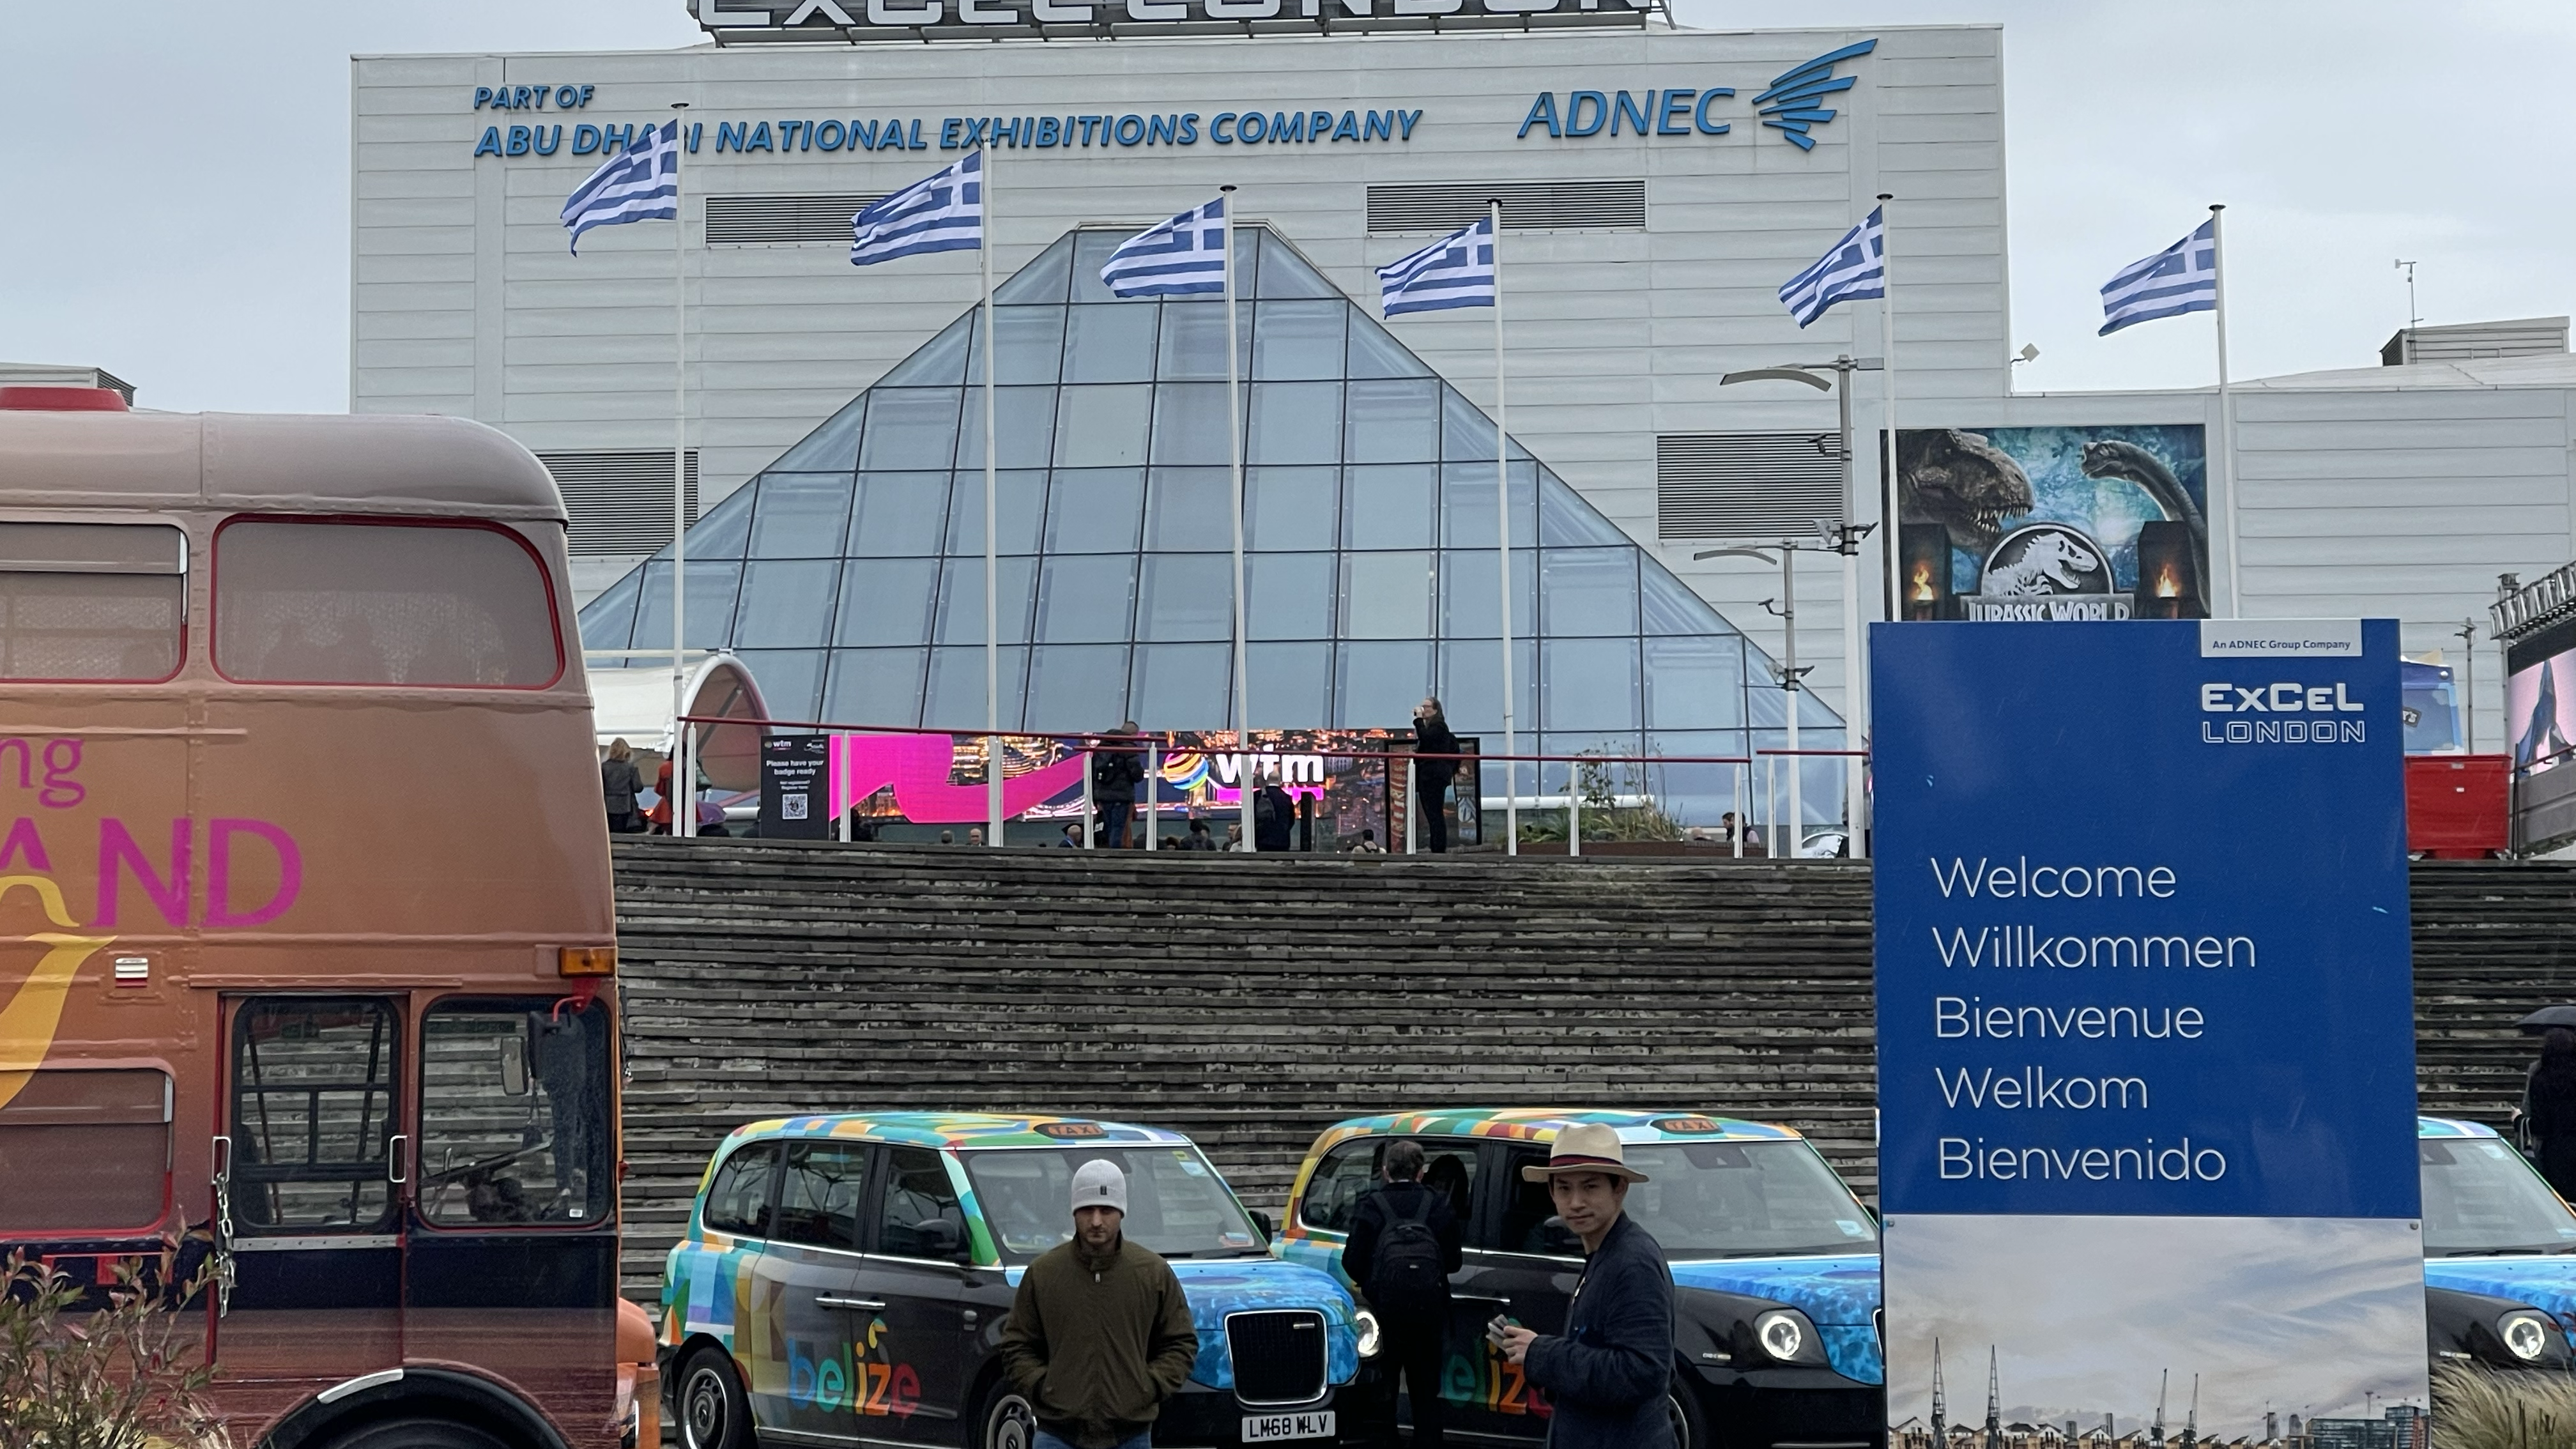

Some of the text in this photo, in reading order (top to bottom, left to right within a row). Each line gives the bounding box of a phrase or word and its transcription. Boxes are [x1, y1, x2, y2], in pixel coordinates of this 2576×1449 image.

[473, 85, 595, 109] PART OF
[1517, 87, 1736, 137] ADNEC
[474, 125, 562, 157] ABU
[716, 119, 927, 152] NATIONAL
[940, 113, 1199, 148] EXHIBITIONS
[1210, 109, 1423, 144] COMPANY
[2212, 640, 2350, 650] An ADNEC Group Company
[2202, 721, 2365, 743] LONDON
[1931, 856, 2175, 898] Welcome
[1933, 926, 2255, 967] Willkommen
[1936, 997, 2204, 1038] Bienvenue
[1936, 1066, 2147, 1108] Welkom
[1053, 1125, 1101, 1135] TAXI
[1667, 1121, 1716, 1130] TAXI
[1940, 1138, 2226, 1180] Bienvenido
[786, 1338, 921, 1418] belize
[1249, 1414, 1328, 1438] LM68 WLV
